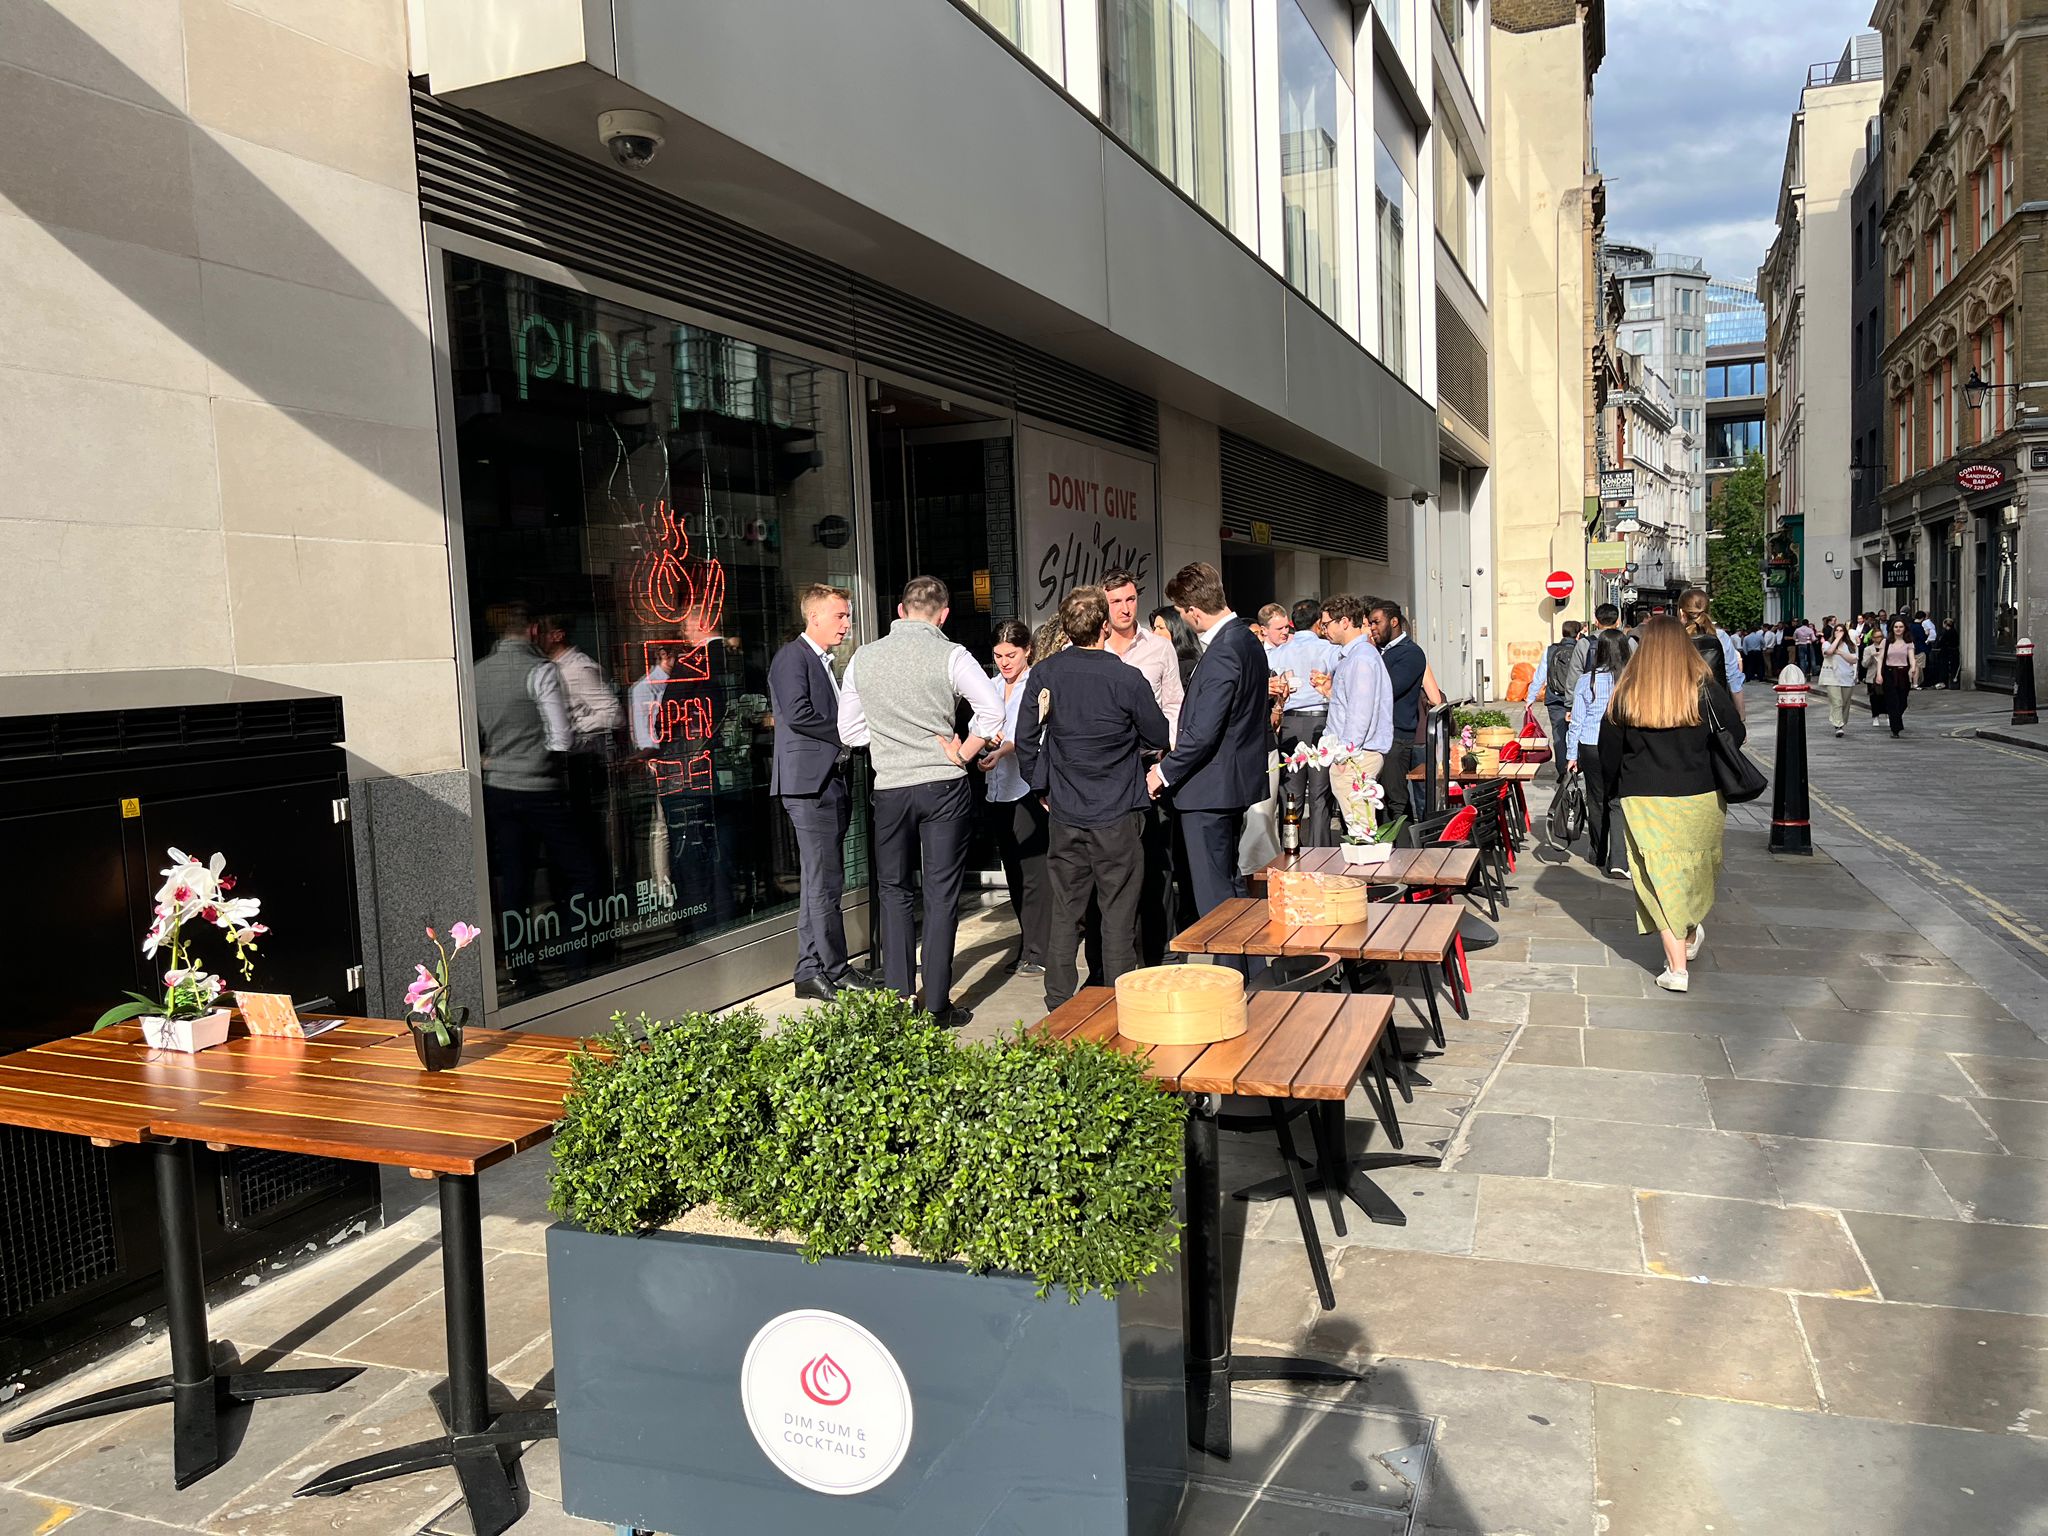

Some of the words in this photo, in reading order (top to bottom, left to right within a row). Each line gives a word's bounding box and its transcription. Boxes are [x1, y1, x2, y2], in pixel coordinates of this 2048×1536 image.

[1601, 477, 1632, 485] LONDON
[1958, 465, 2002, 478] CONTINENTAL
[1048, 472, 1099, 514] DON'T
[1105, 486, 1137, 520] GIVE
[649, 697, 712, 744] OPEN
[502, 907, 560, 951] Dim
[569, 892, 629, 933] Sum
[636, 875, 678, 916] 點心
[505, 951, 535, 970] Little
[538, 931, 588, 961] steamed
[591, 921, 629, 949] parcels
[632, 916, 643, 933] of
[645, 901, 708, 929] deliciousness
[783, 1430, 866, 1459] COCKTAILS
[784, 1413, 813, 1430] DIM
[818, 1420, 851, 1438] SUM
[857, 1428, 867, 1442] &
